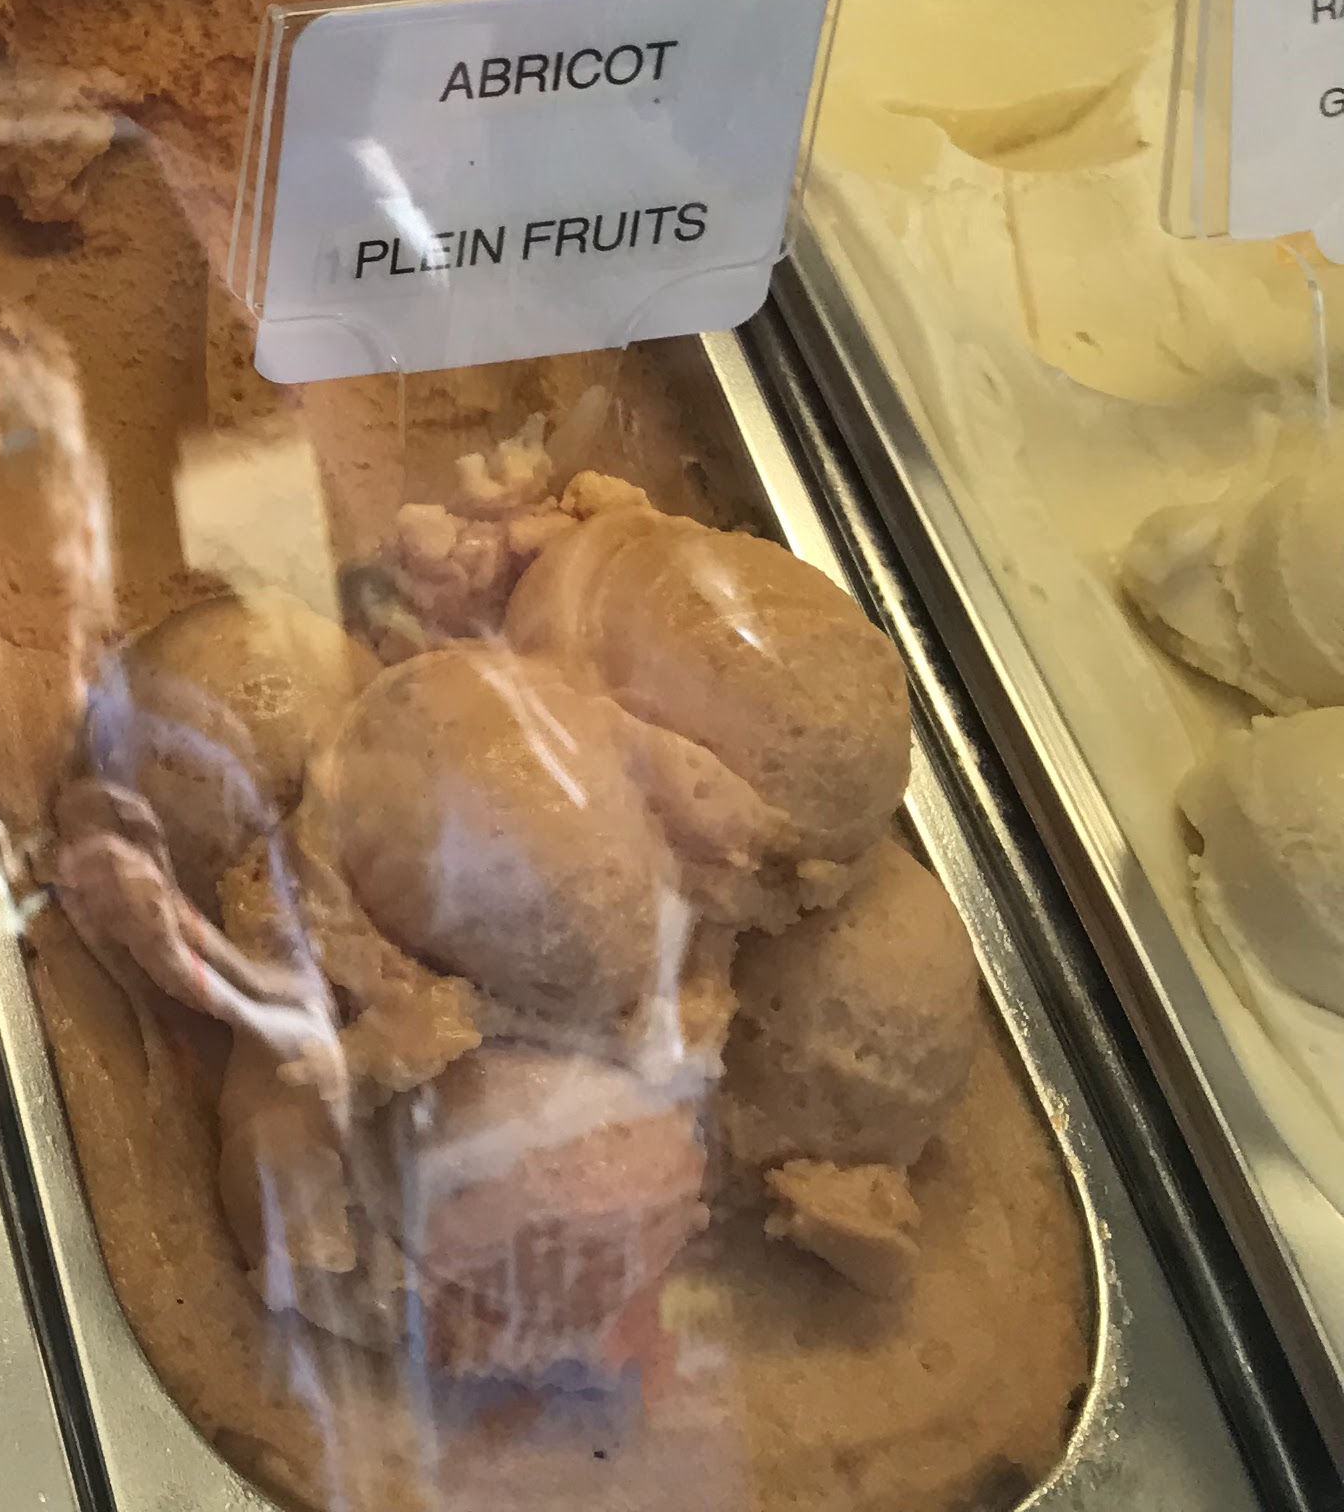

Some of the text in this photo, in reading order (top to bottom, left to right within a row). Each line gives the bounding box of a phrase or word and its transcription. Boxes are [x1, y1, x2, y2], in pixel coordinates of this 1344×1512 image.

[439, 40, 679, 103] ABRICOT
[354, 201, 709, 280] PLEIN FRUITS
